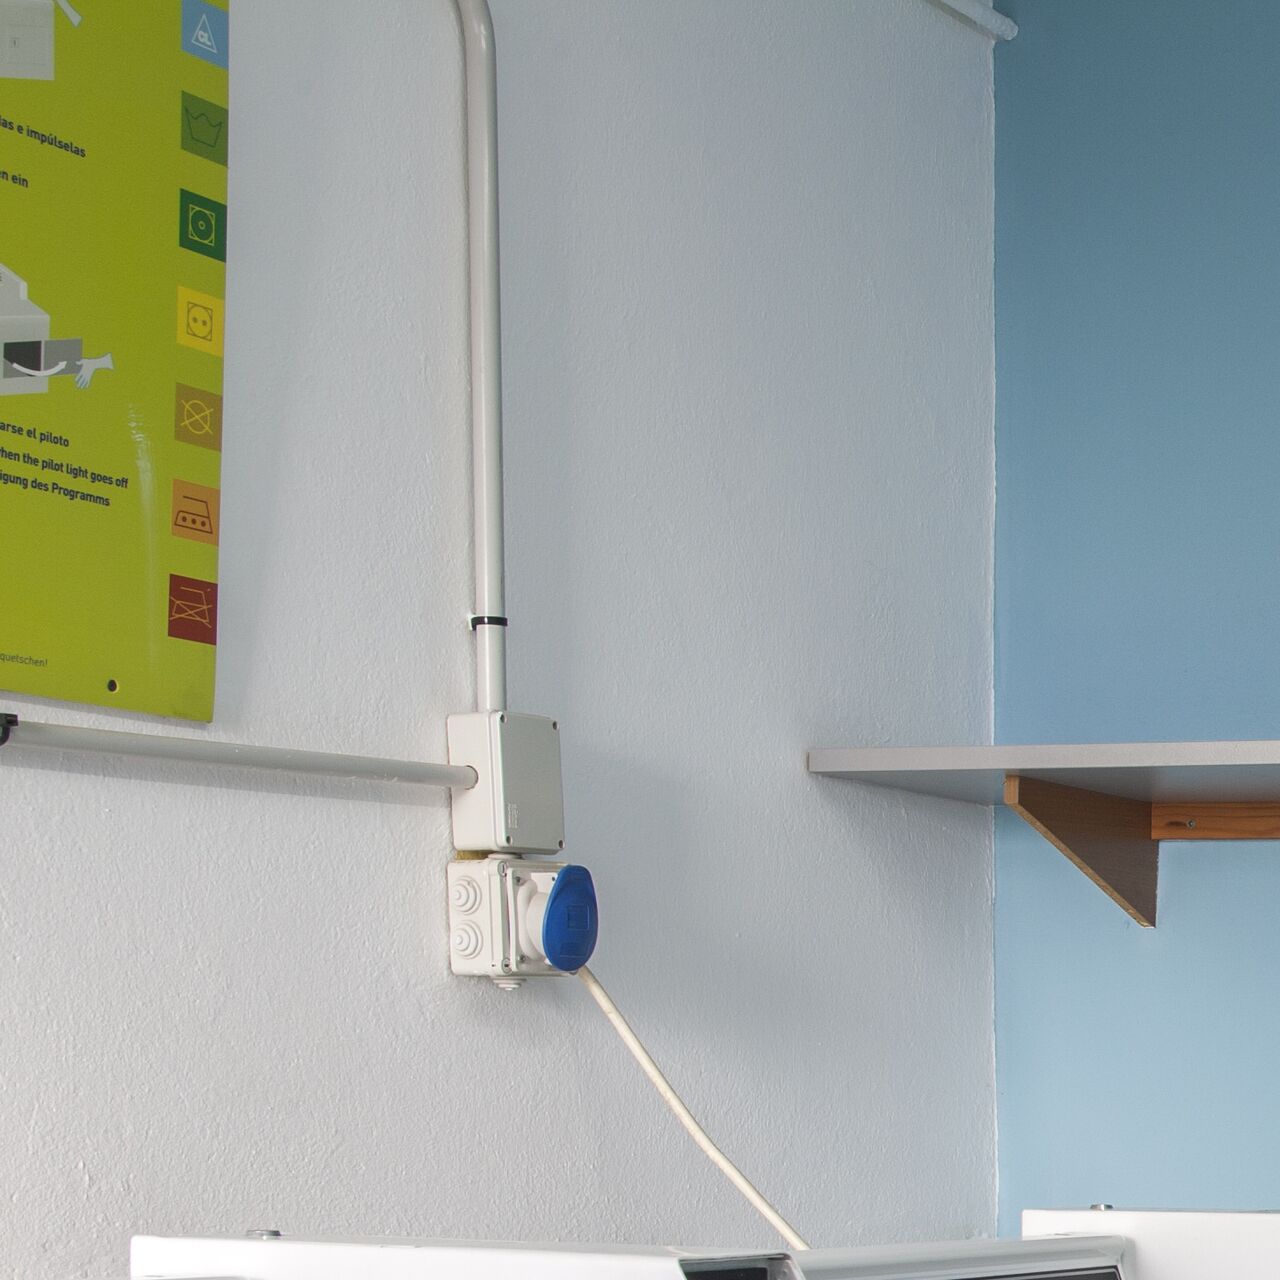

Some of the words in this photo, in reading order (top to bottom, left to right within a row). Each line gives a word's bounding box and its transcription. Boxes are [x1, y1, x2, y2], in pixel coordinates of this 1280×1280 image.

[17, 124, 24, 134] e
[26, 125, 86, 158] impúlselas
[11, 173, 29, 188] ein
[26, 428, 37, 440] el
[39, 431, 70, 447] piloto
[0, 446, 21, 462] hen
[22, 453, 40, 466] the
[41, 458, 65, 472] pilot
[66, 462, 88, 480] light
[90, 471, 113, 486] goes
[115, 477, 129, 489] off
[30, 478, 49, 492] des
[51, 482, 111, 507] Programms
